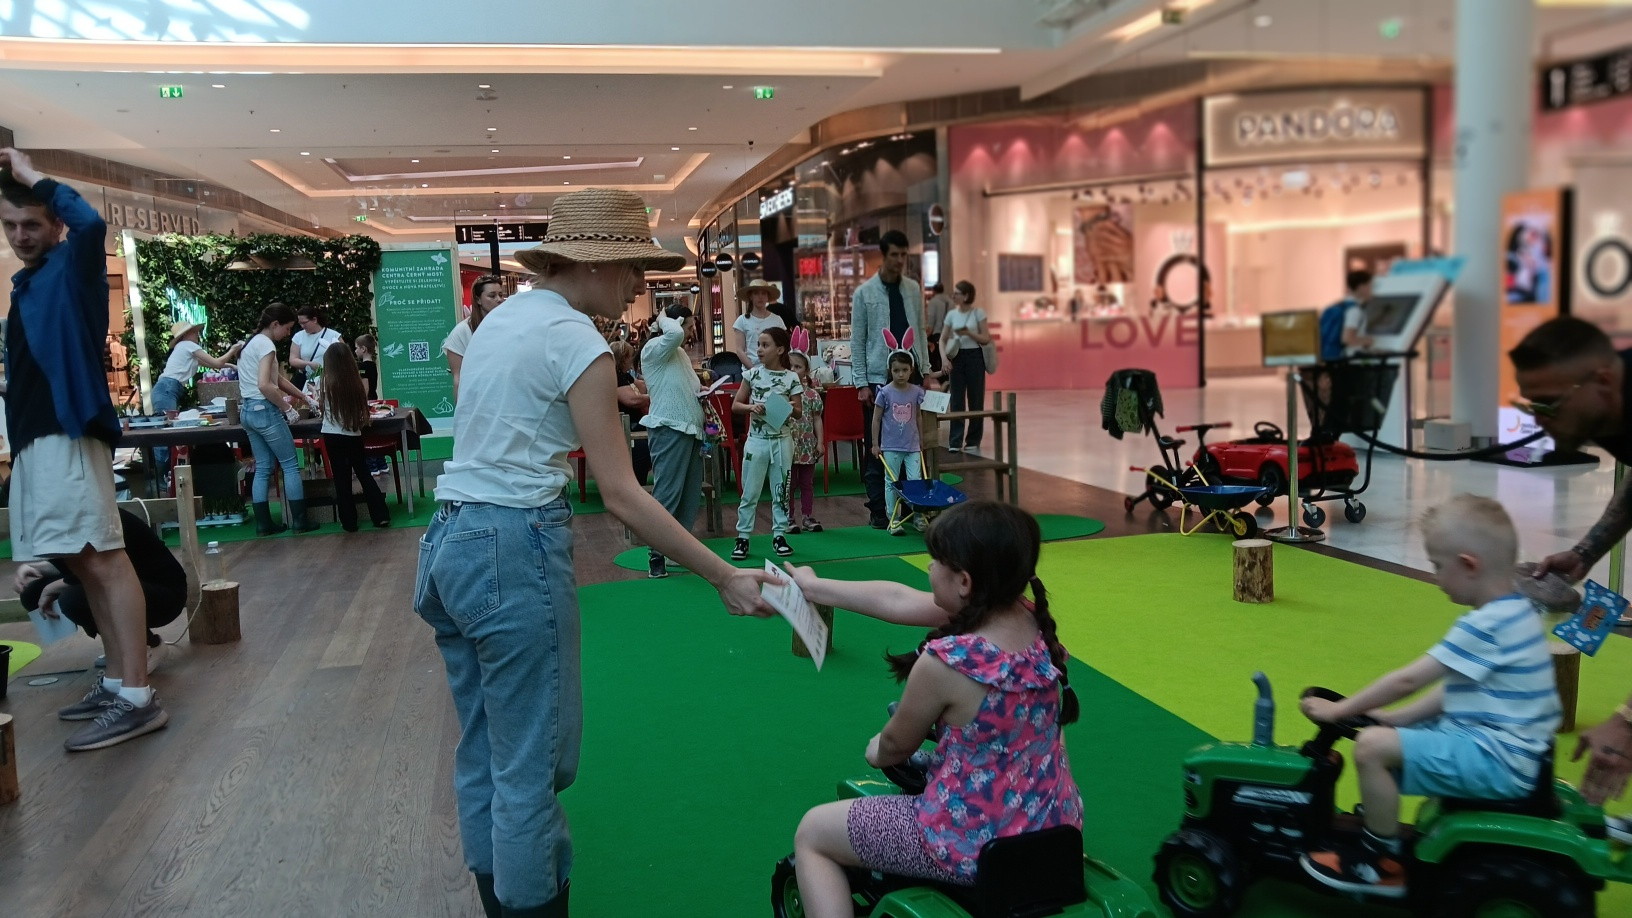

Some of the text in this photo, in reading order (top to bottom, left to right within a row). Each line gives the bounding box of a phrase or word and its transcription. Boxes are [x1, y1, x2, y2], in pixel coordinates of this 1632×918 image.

[1236, 106, 1399, 143] PANDORA
[111, 203, 200, 236] RESERVED
[1080, 315, 1198, 350] LOVE
